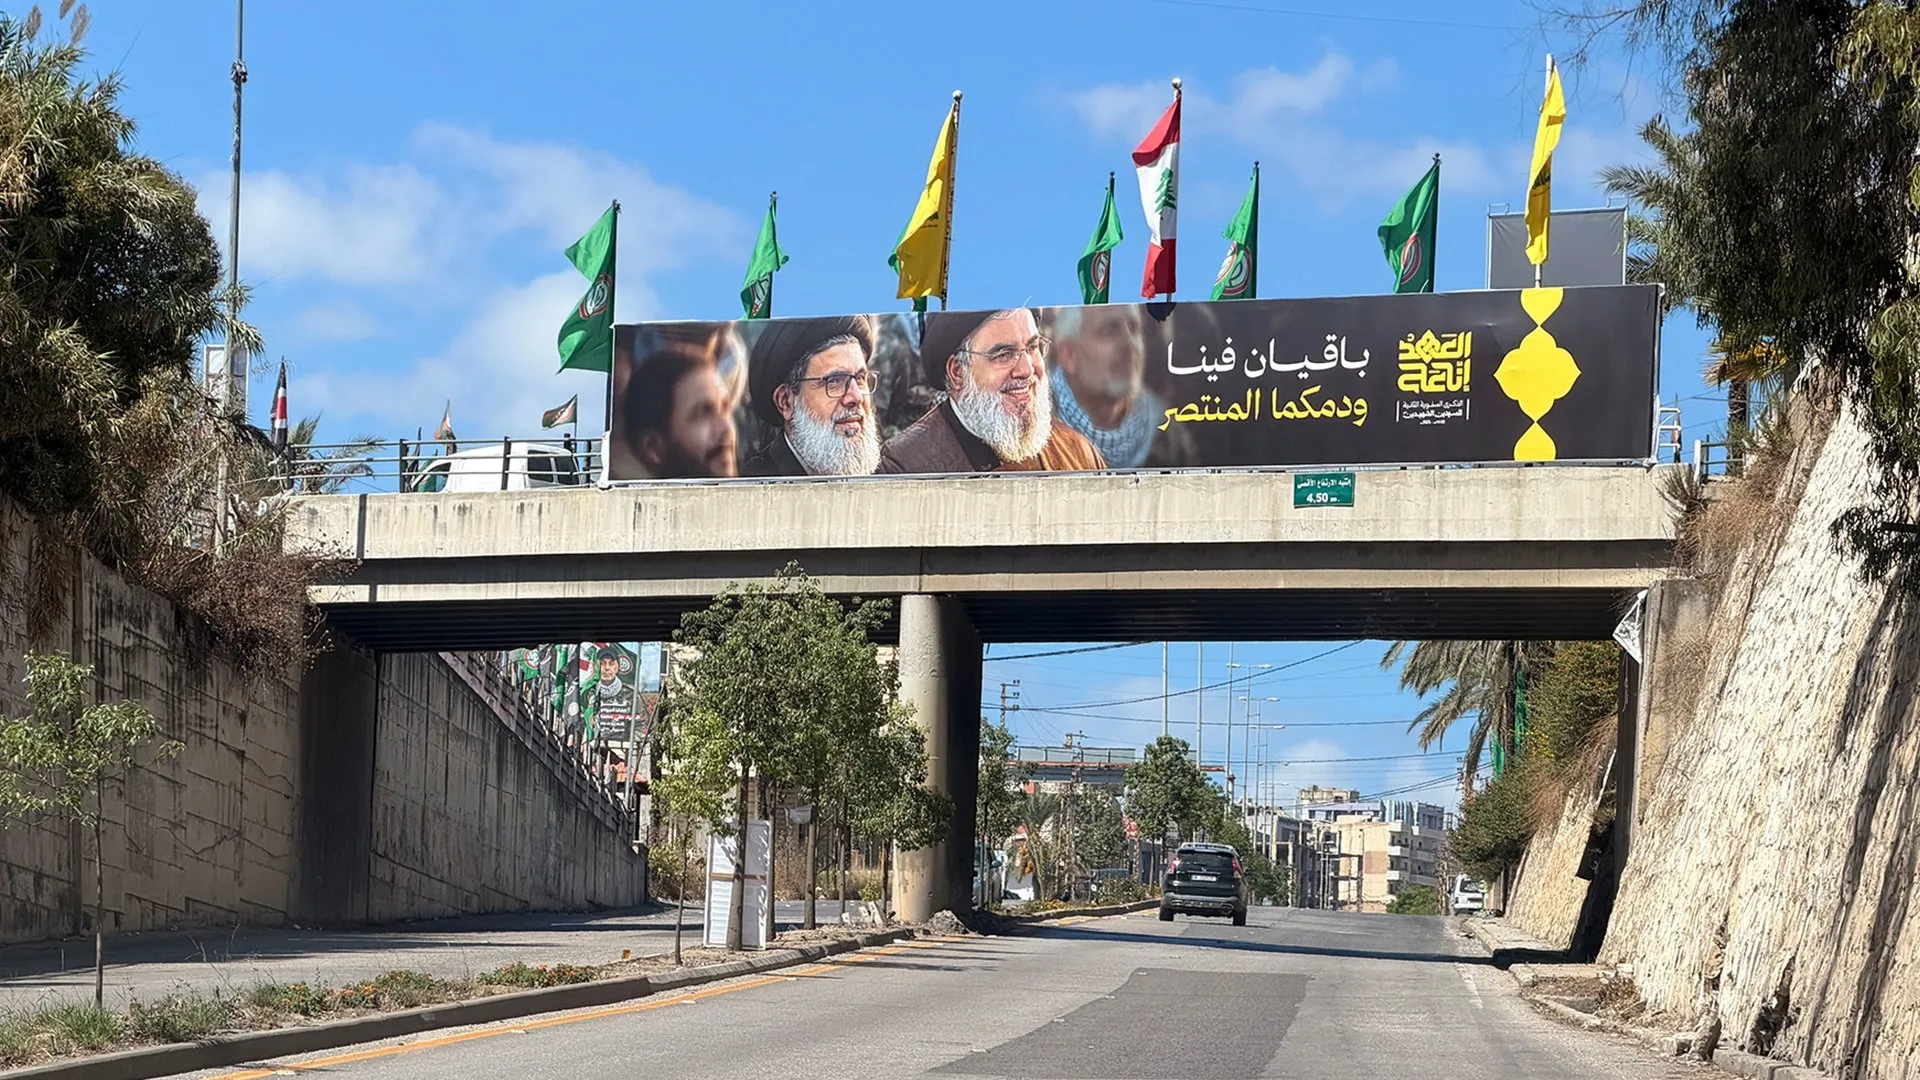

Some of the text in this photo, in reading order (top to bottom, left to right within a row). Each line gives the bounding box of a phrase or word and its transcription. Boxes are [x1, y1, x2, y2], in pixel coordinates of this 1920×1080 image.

[1167, 333, 1370, 382] باقيان فينا
[1157, 384, 1368, 431] ودمكما المنتصر
